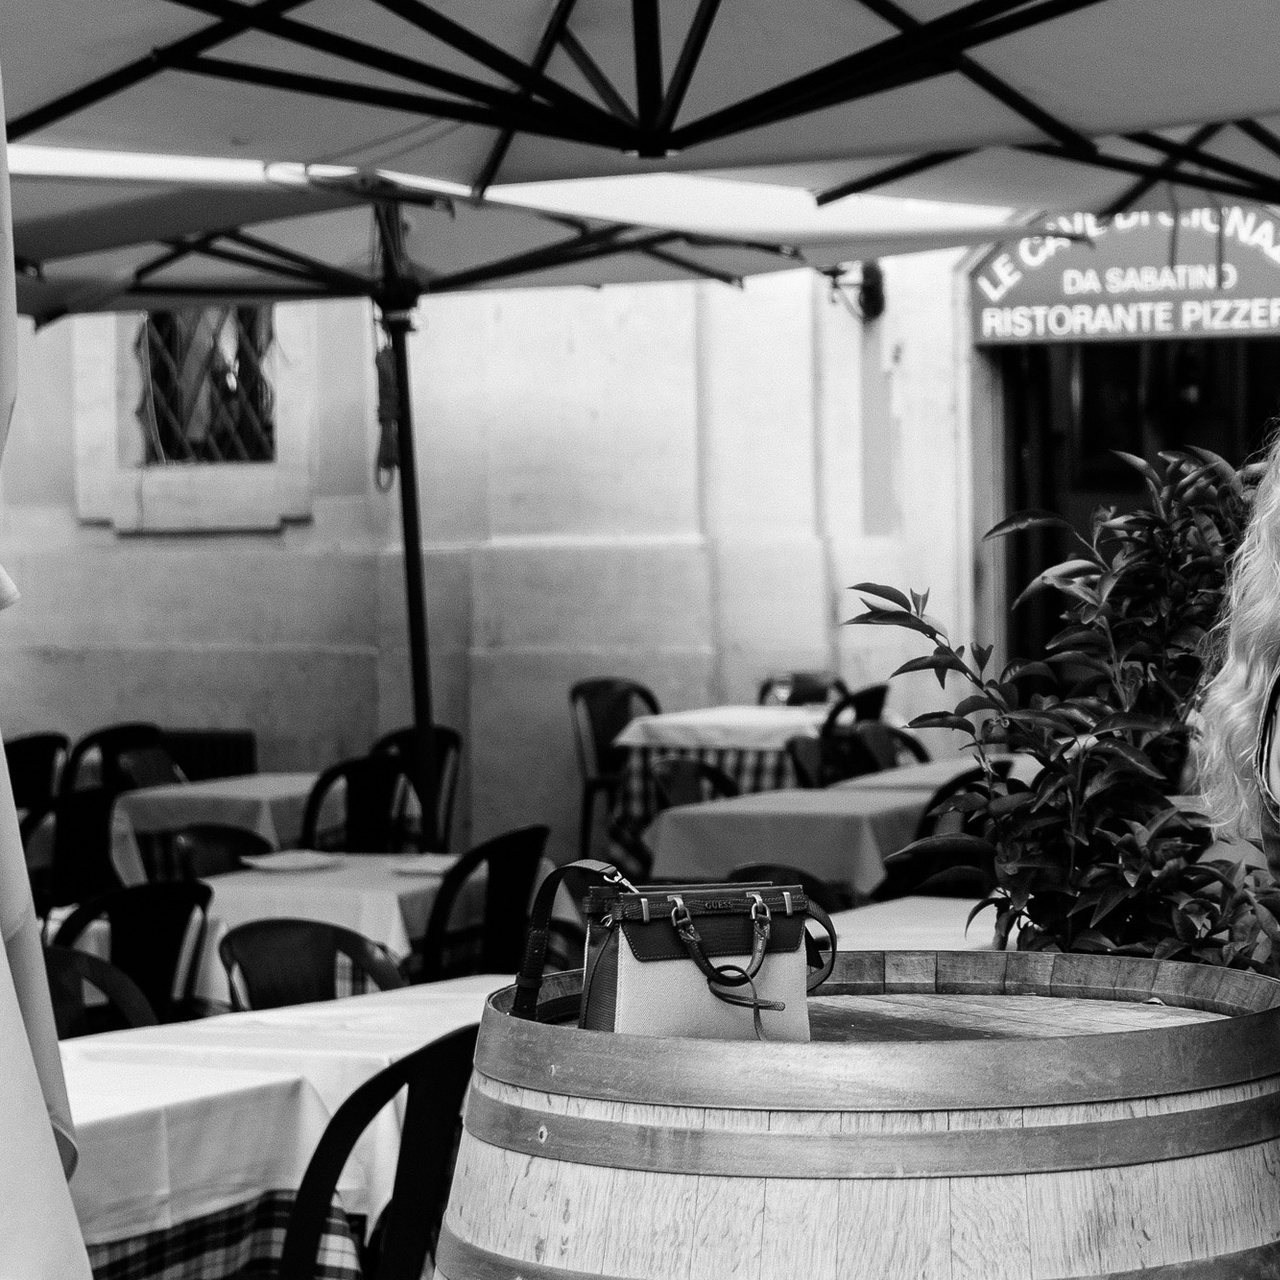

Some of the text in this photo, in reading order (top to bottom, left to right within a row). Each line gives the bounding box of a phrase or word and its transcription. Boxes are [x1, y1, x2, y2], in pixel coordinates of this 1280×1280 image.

[978, 253, 1023, 302] LE
[1062, 264, 1238, 295] DA SABATINO
[982, 302, 1174, 338] RISTORANTE
[705, 901, 734, 910] GUESS
